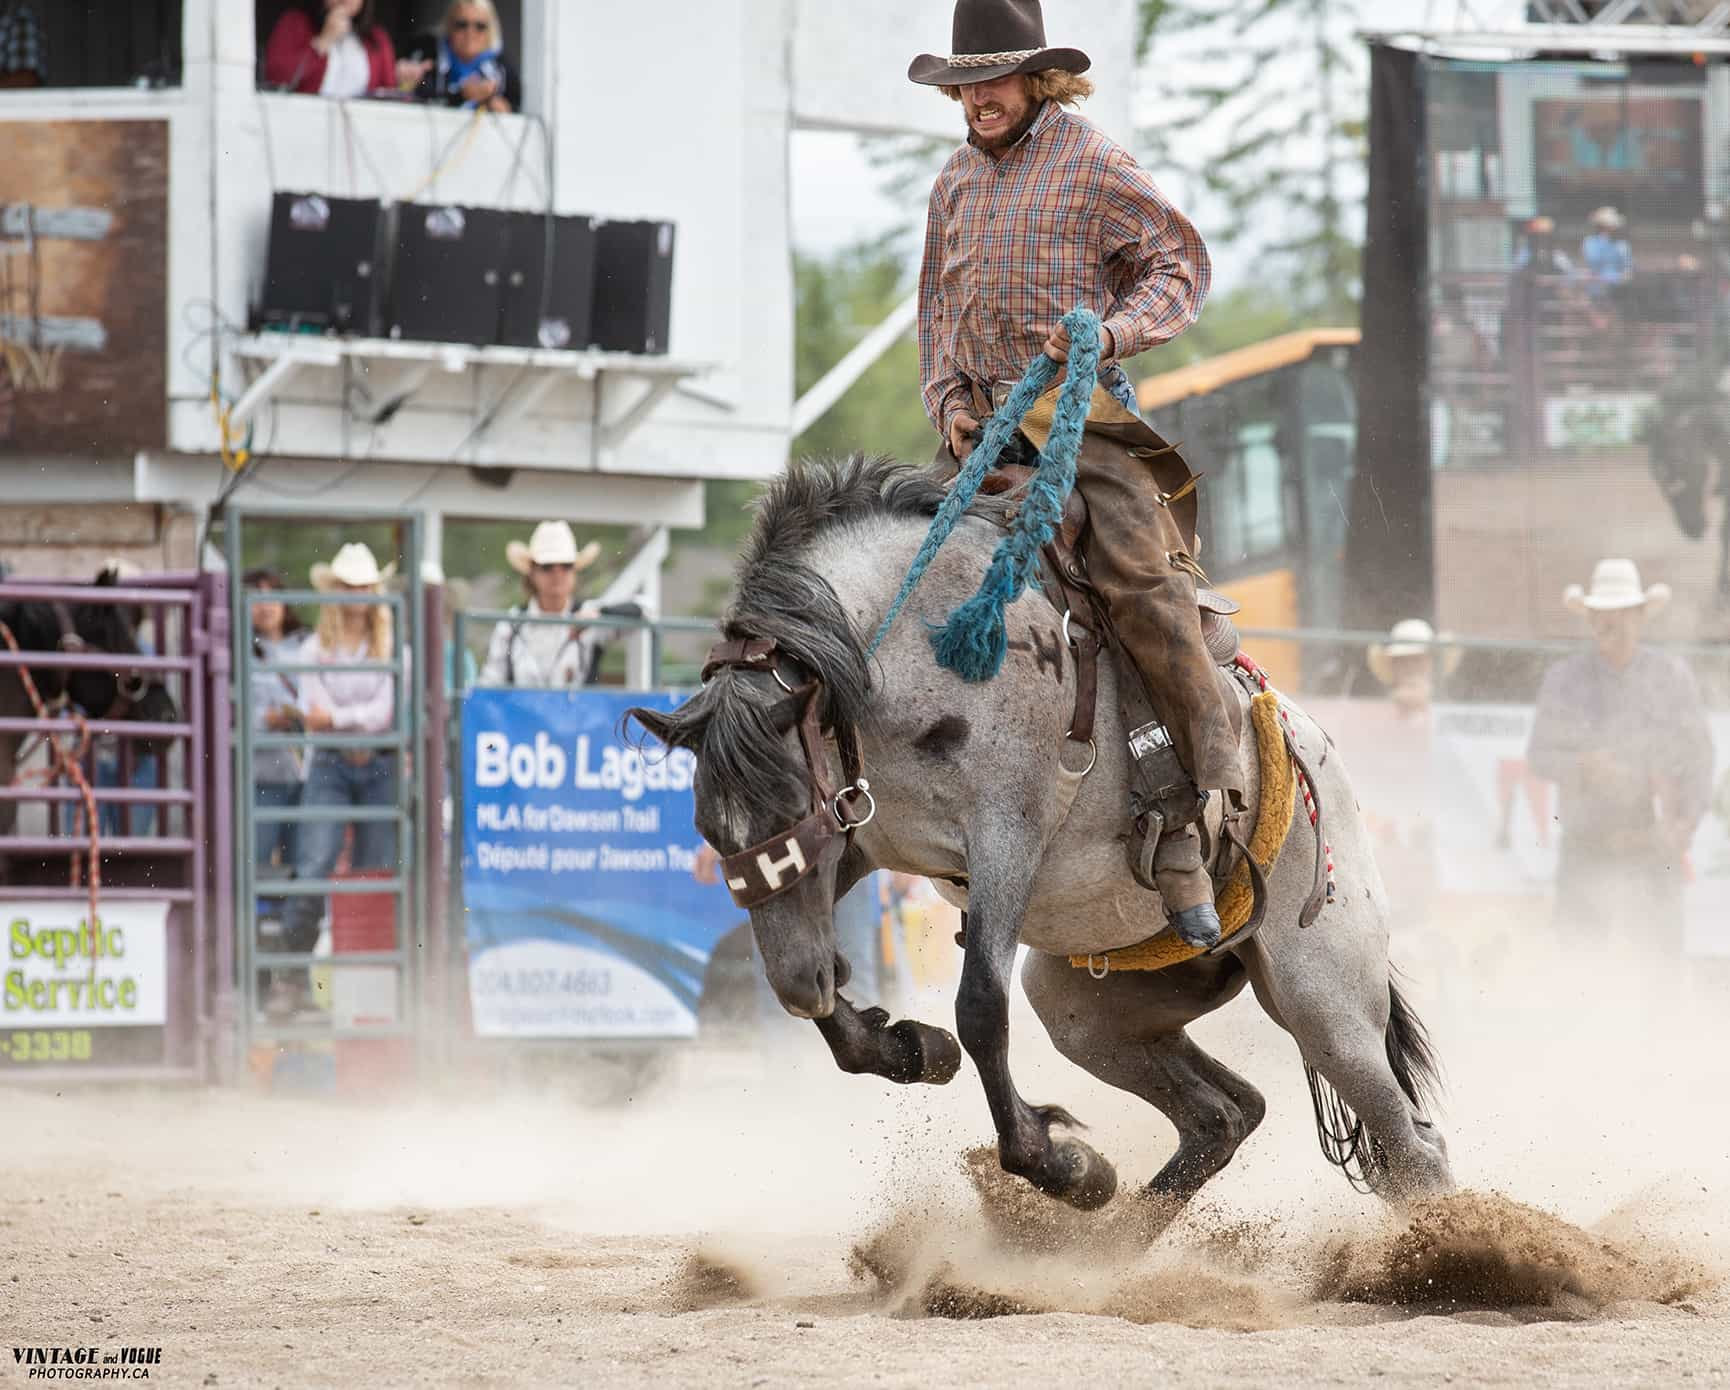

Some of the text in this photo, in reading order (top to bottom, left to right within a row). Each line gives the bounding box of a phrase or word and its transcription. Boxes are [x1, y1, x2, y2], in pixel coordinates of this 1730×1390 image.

[475, 731, 566, 789] Bob
[477, 804, 658, 832] MLA for Dawson Trail
[551, 847, 596, 874] pour
[600, 844, 665, 870] Dawson
[667, 844, 694, 871] Tra
[9, 918, 125, 968] Septic
[4, 968, 137, 1011] Service
